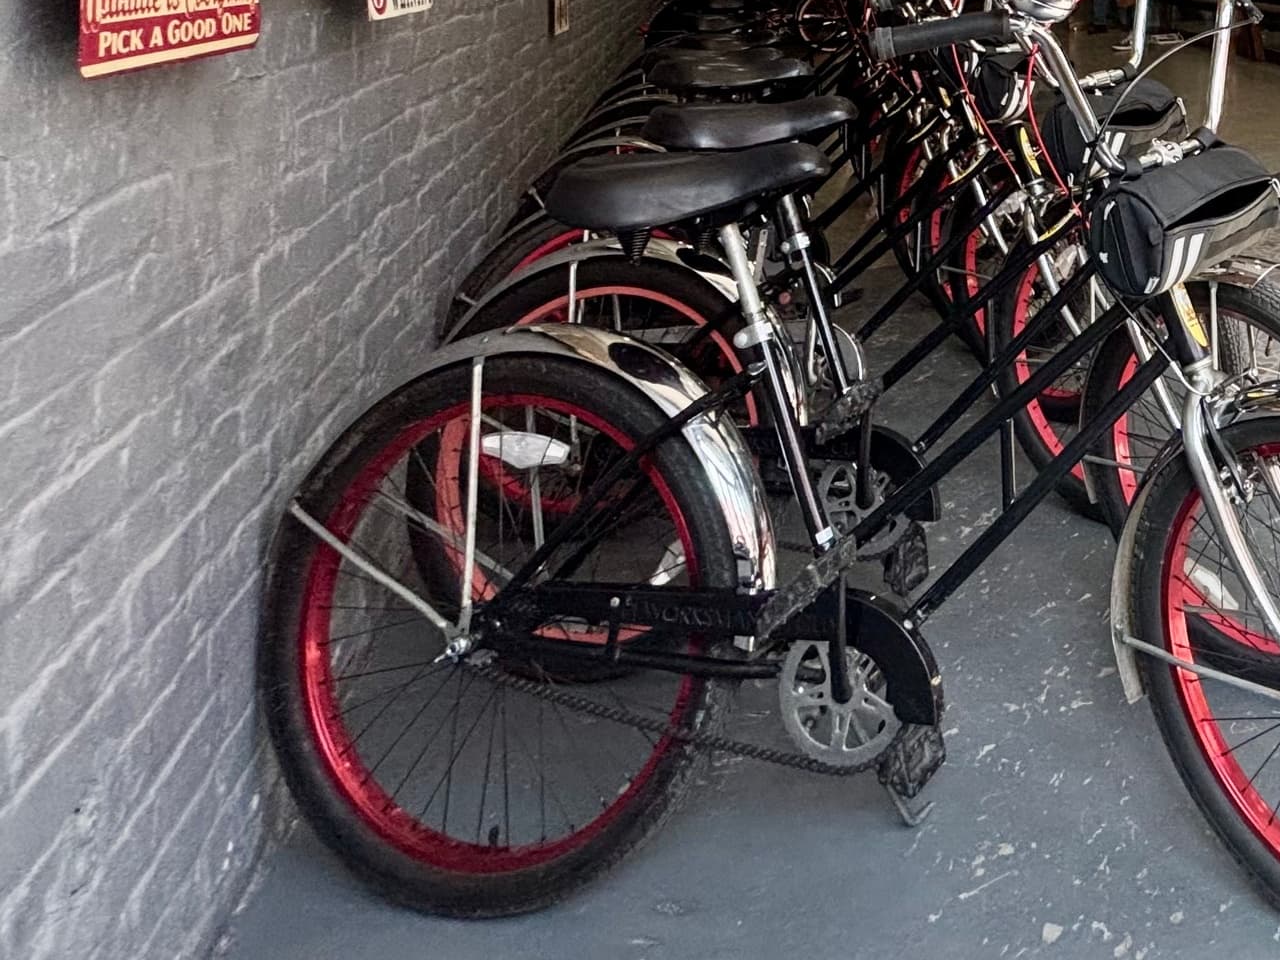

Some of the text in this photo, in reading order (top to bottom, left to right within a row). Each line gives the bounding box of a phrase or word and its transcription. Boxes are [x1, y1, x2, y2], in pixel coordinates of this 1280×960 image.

[98, 12, 251, 57] PICK A GOOD ONE
